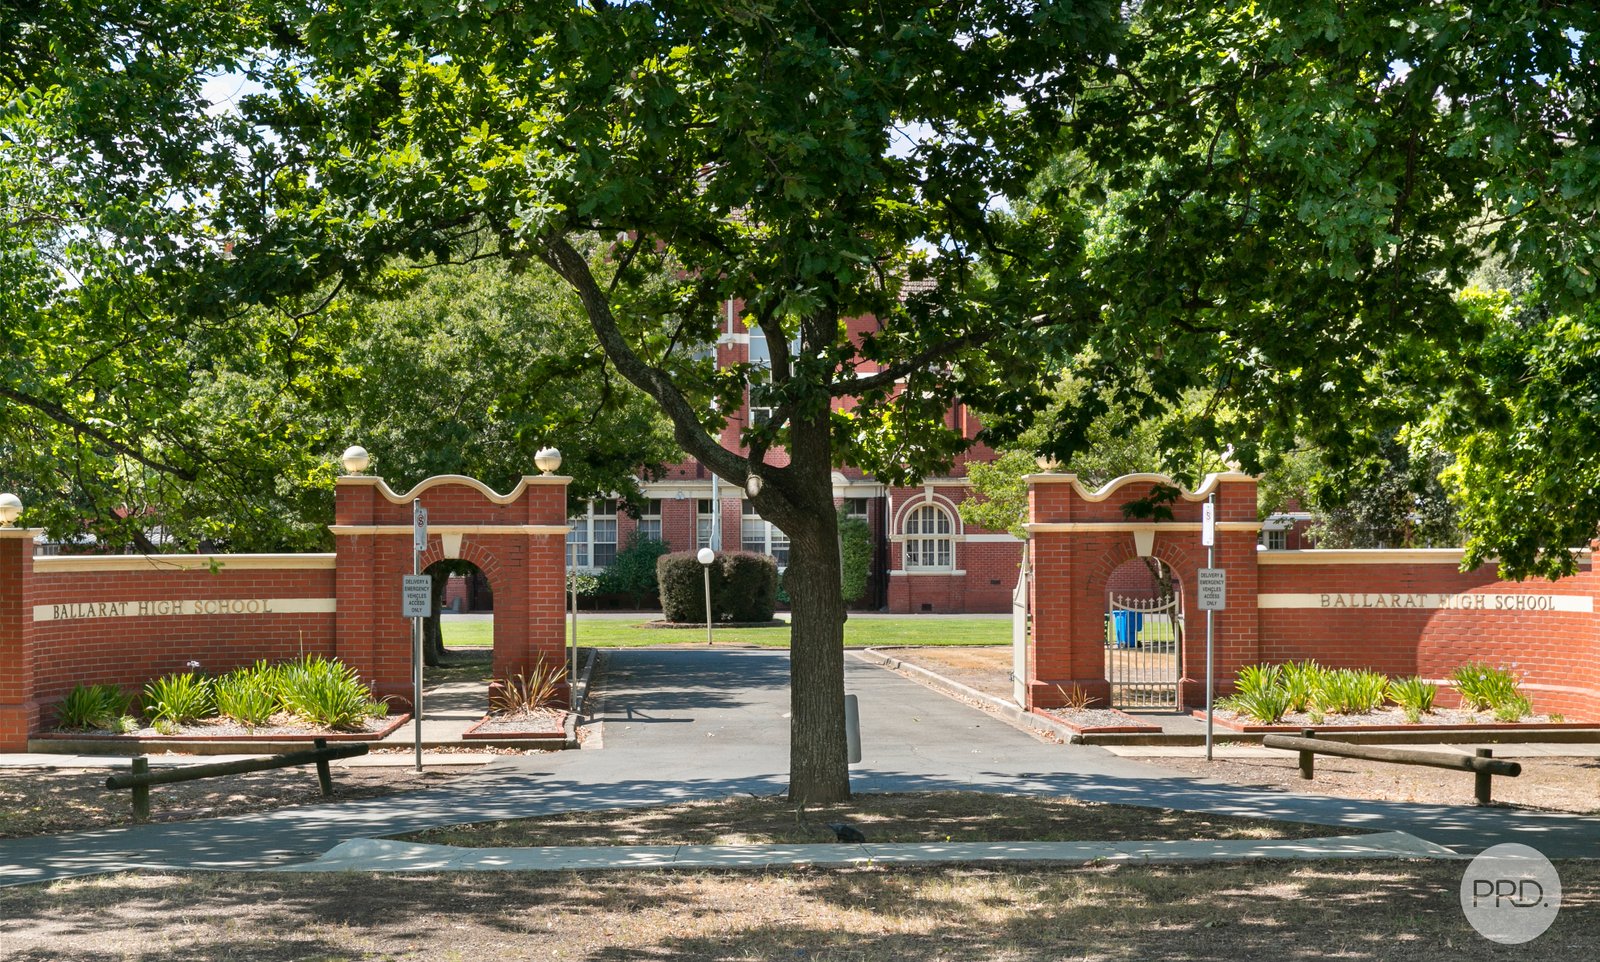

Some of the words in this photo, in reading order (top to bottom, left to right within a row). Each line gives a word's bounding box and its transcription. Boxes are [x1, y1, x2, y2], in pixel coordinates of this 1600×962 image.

[53, 602, 128, 620] BALLARAT
[138, 600, 184, 616] HIGH
[194, 600, 272, 614] SCHOOL
[1320, 594, 1428, 608] BALLARAT
[1439, 594, 1486, 609] HIGH
[1495, 594, 1556, 610] SCHOOL
